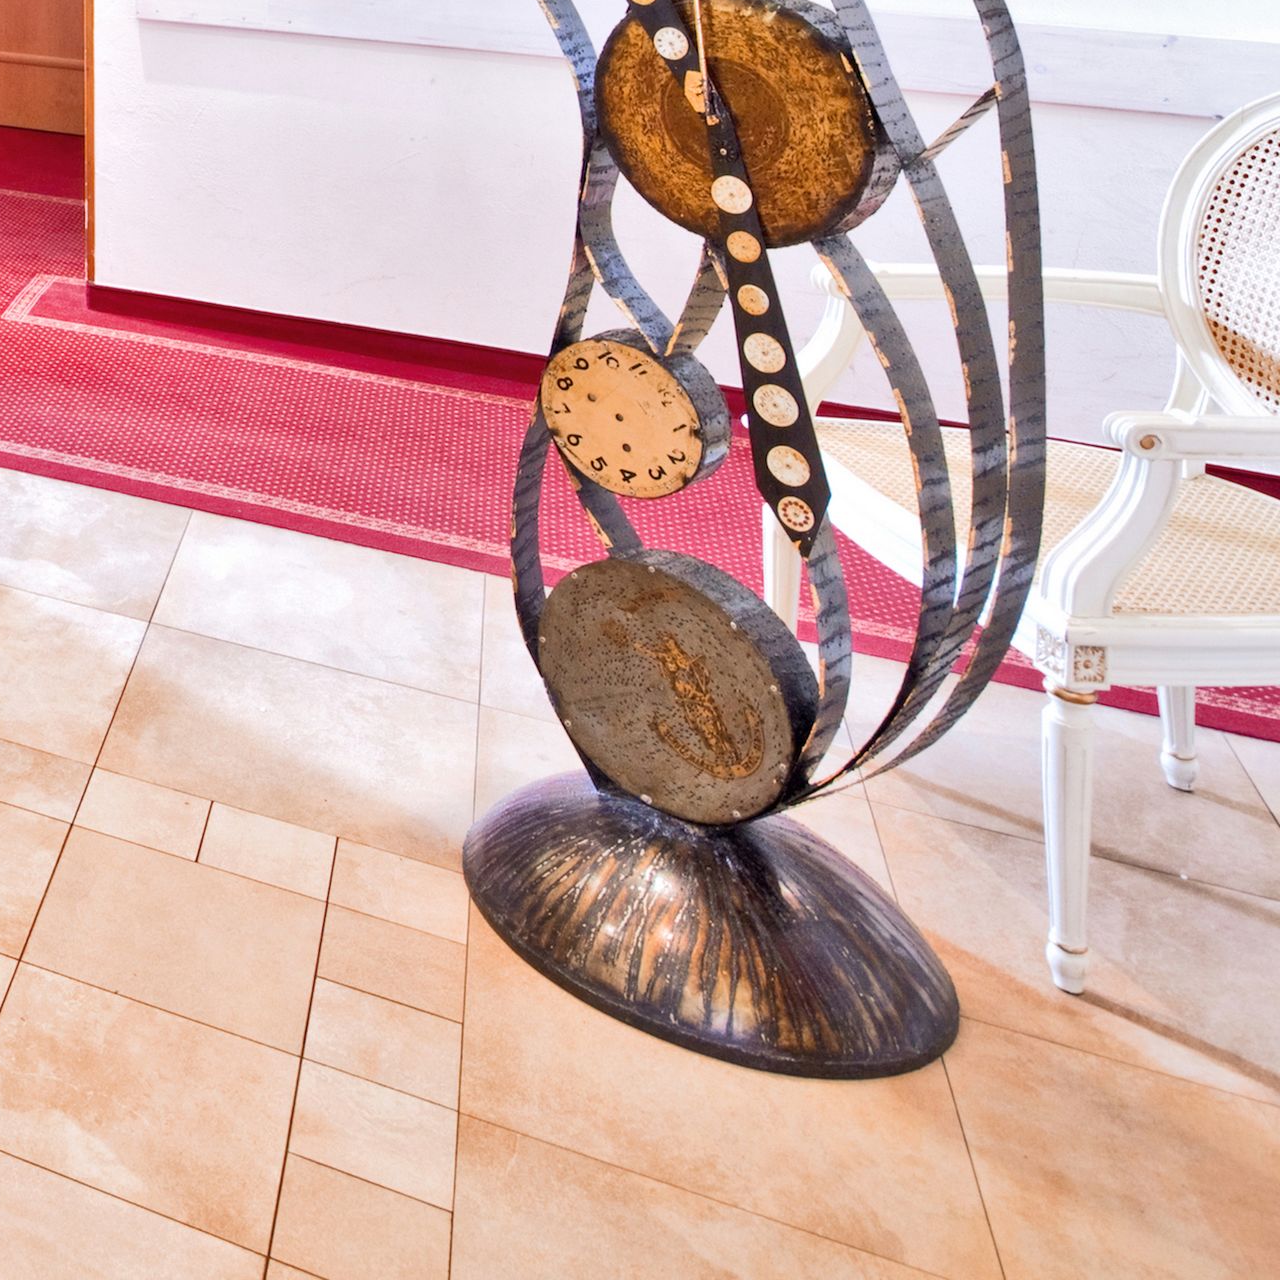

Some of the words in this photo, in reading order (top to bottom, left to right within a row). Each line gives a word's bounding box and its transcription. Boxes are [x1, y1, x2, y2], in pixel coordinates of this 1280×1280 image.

[572, 357, 589, 371] 9
[556, 376, 574, 391] 8
[567, 433, 583, 447] 6
[590, 456, 609, 472] 5
[666, 448, 687, 465] 2
[619, 468, 637, 484] 4
[648, 465, 668, 481] 3
